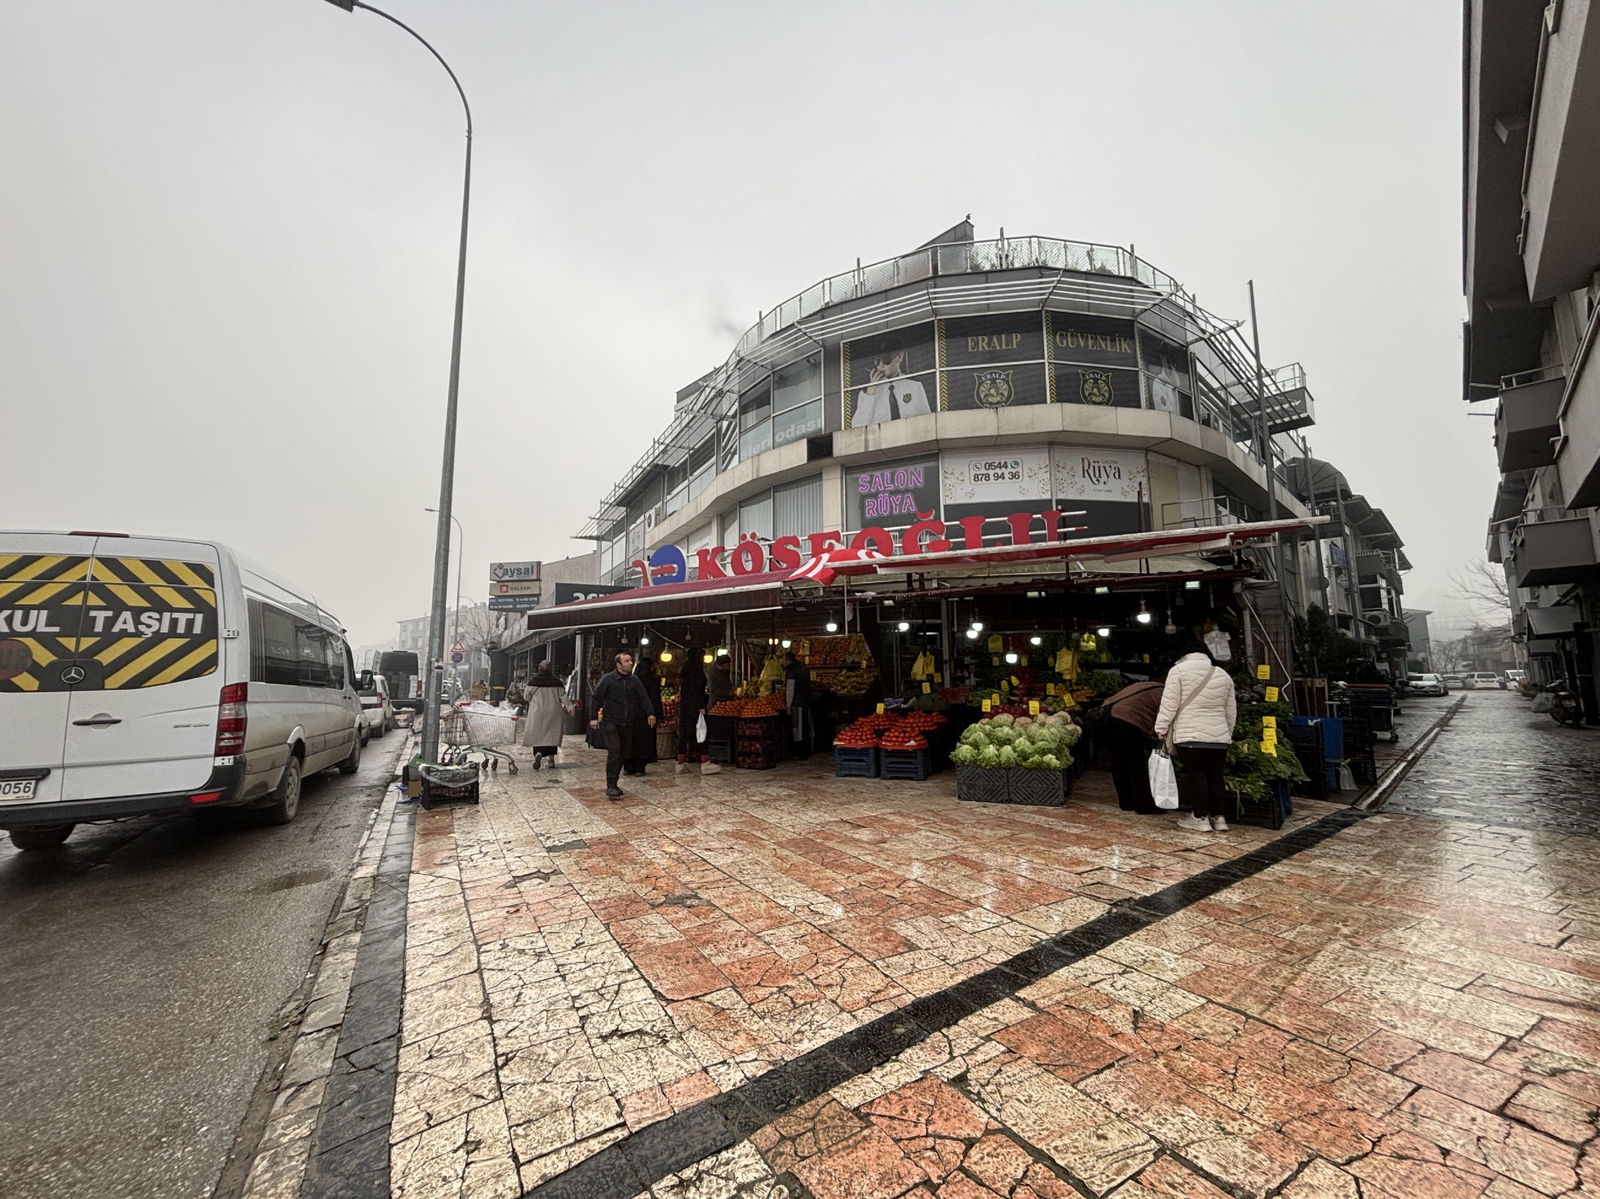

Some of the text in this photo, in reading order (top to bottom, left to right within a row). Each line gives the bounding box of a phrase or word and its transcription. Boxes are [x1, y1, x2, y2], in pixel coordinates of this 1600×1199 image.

[967, 329, 1132, 353] ERALP GÜVENLİK
[981, 373, 1006, 381] ERALP
[973, 471, 1020, 482] 878 94 36
[984, 461, 1008, 471] 0544
[1081, 457, 1121, 485] Rüya
[858, 467, 925, 493] SALON
[865, 493, 916, 518] RÜYA
[89, 610, 204, 638] TAŞITI
[0, 782, 33, 794] 056
